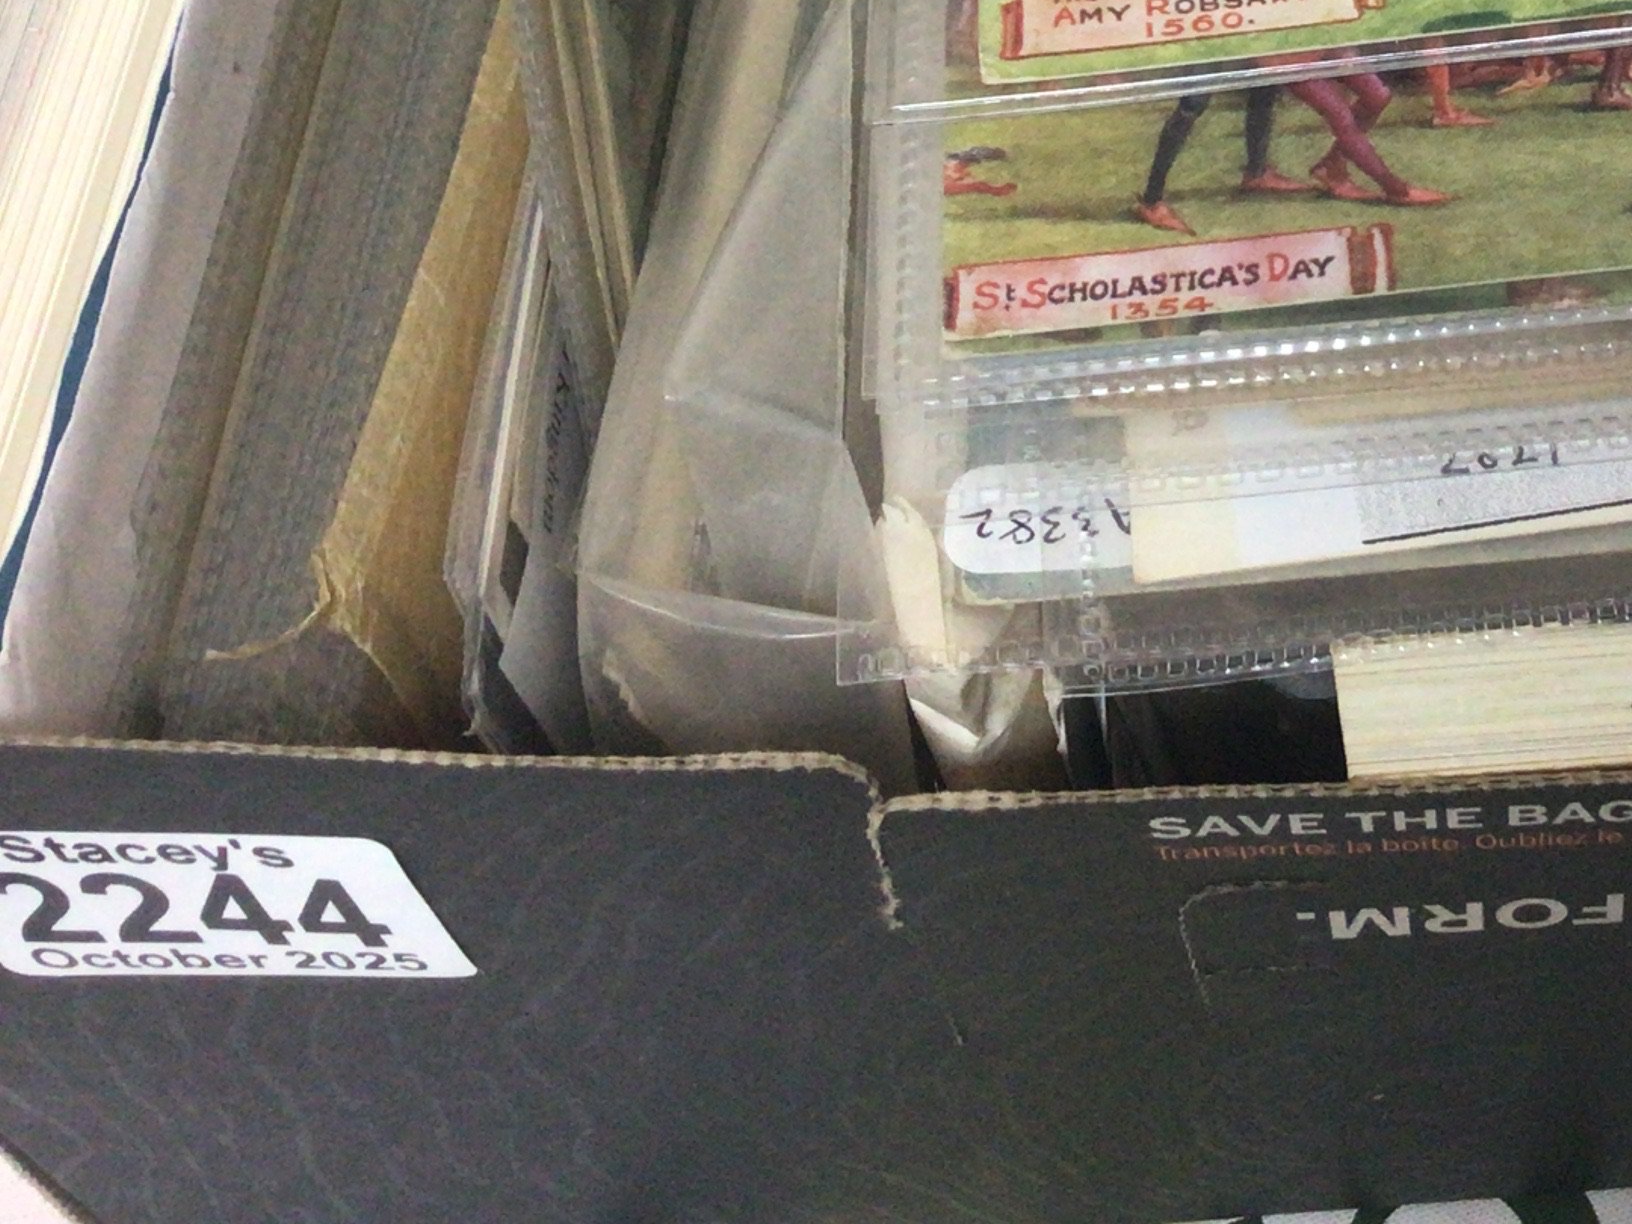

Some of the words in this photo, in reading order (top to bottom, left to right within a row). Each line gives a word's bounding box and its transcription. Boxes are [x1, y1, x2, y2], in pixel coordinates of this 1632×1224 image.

[1053, 3, 1131, 29] AMY
[1021, 262, 1260, 310] SCHOLASTICA'S
[1267, 252, 1335, 282] DAY
[1149, 812, 1327, 839] SAVE
[1345, 807, 1483, 833] THE
[0, 834, 295, 872] Stacey's
[0, 871, 393, 947] 2244
[31, 947, 268, 970] October
[285, 949, 429, 971] 2025
